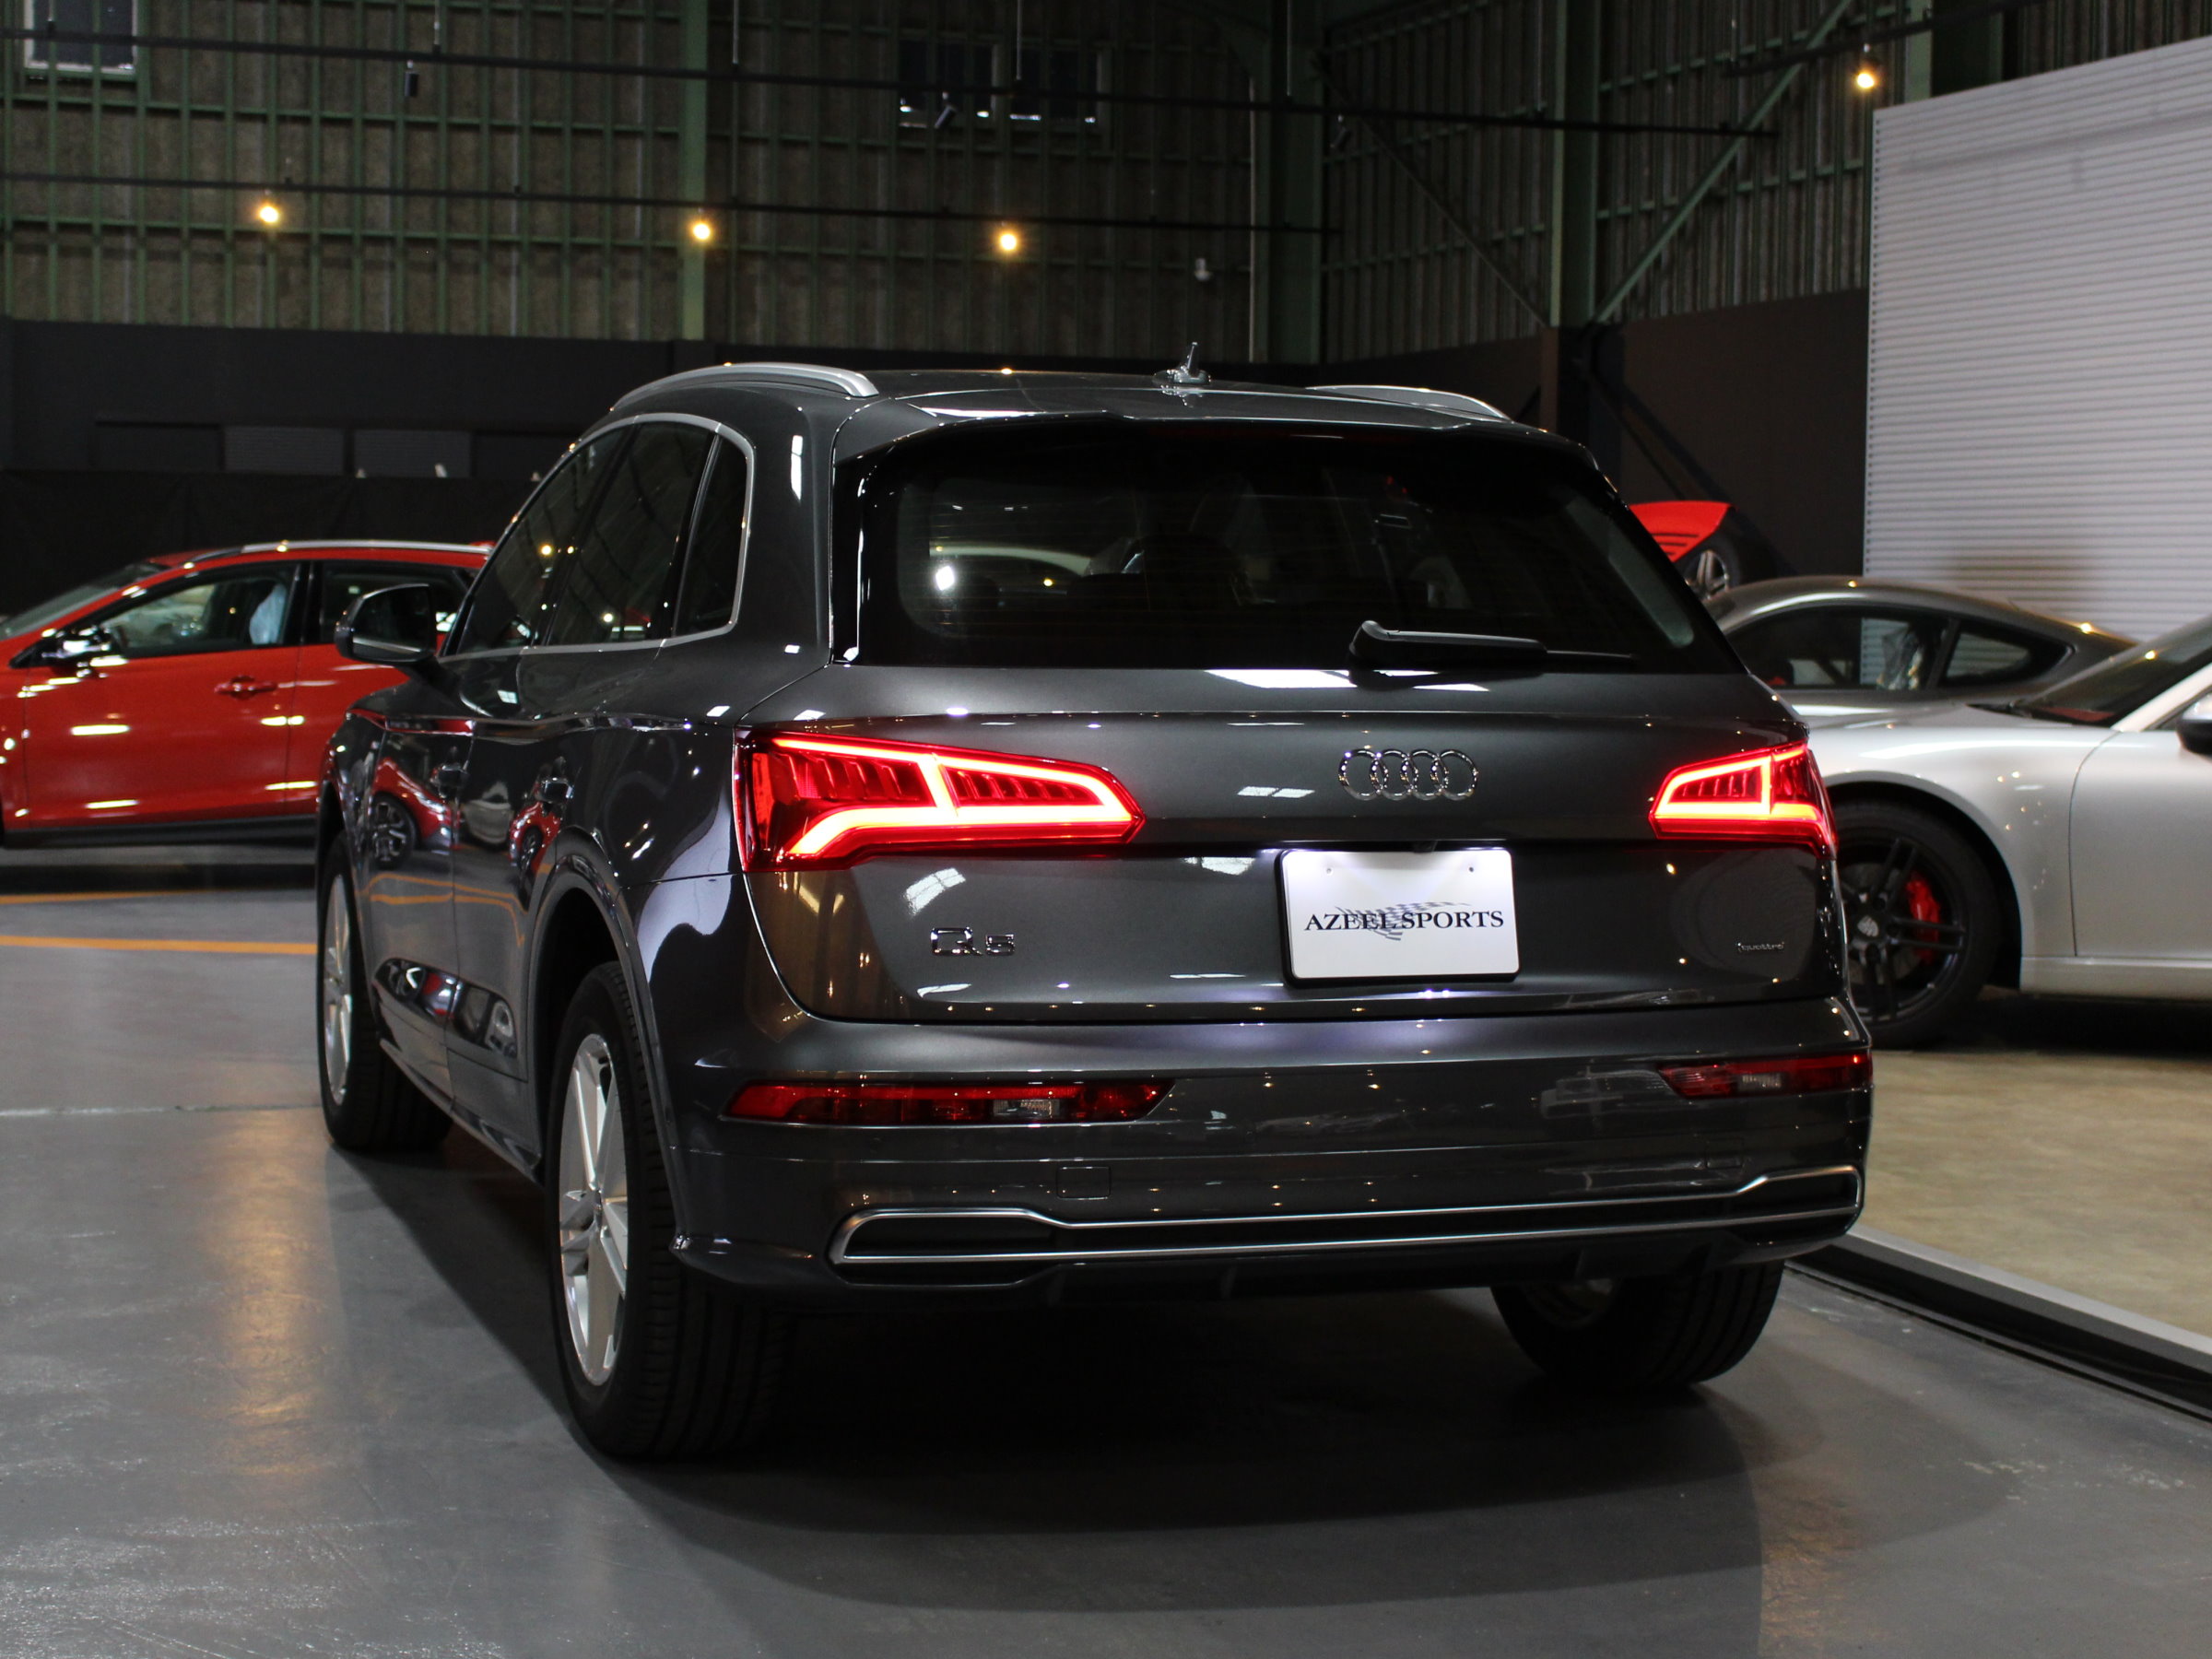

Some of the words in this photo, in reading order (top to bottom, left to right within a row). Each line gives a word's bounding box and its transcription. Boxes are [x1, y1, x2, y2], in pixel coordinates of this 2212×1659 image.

[1400, 910, 1504, 929] SPORTS
[930, 926, 1015, 957] Q5
[1737, 942, 1784, 952] quattro
